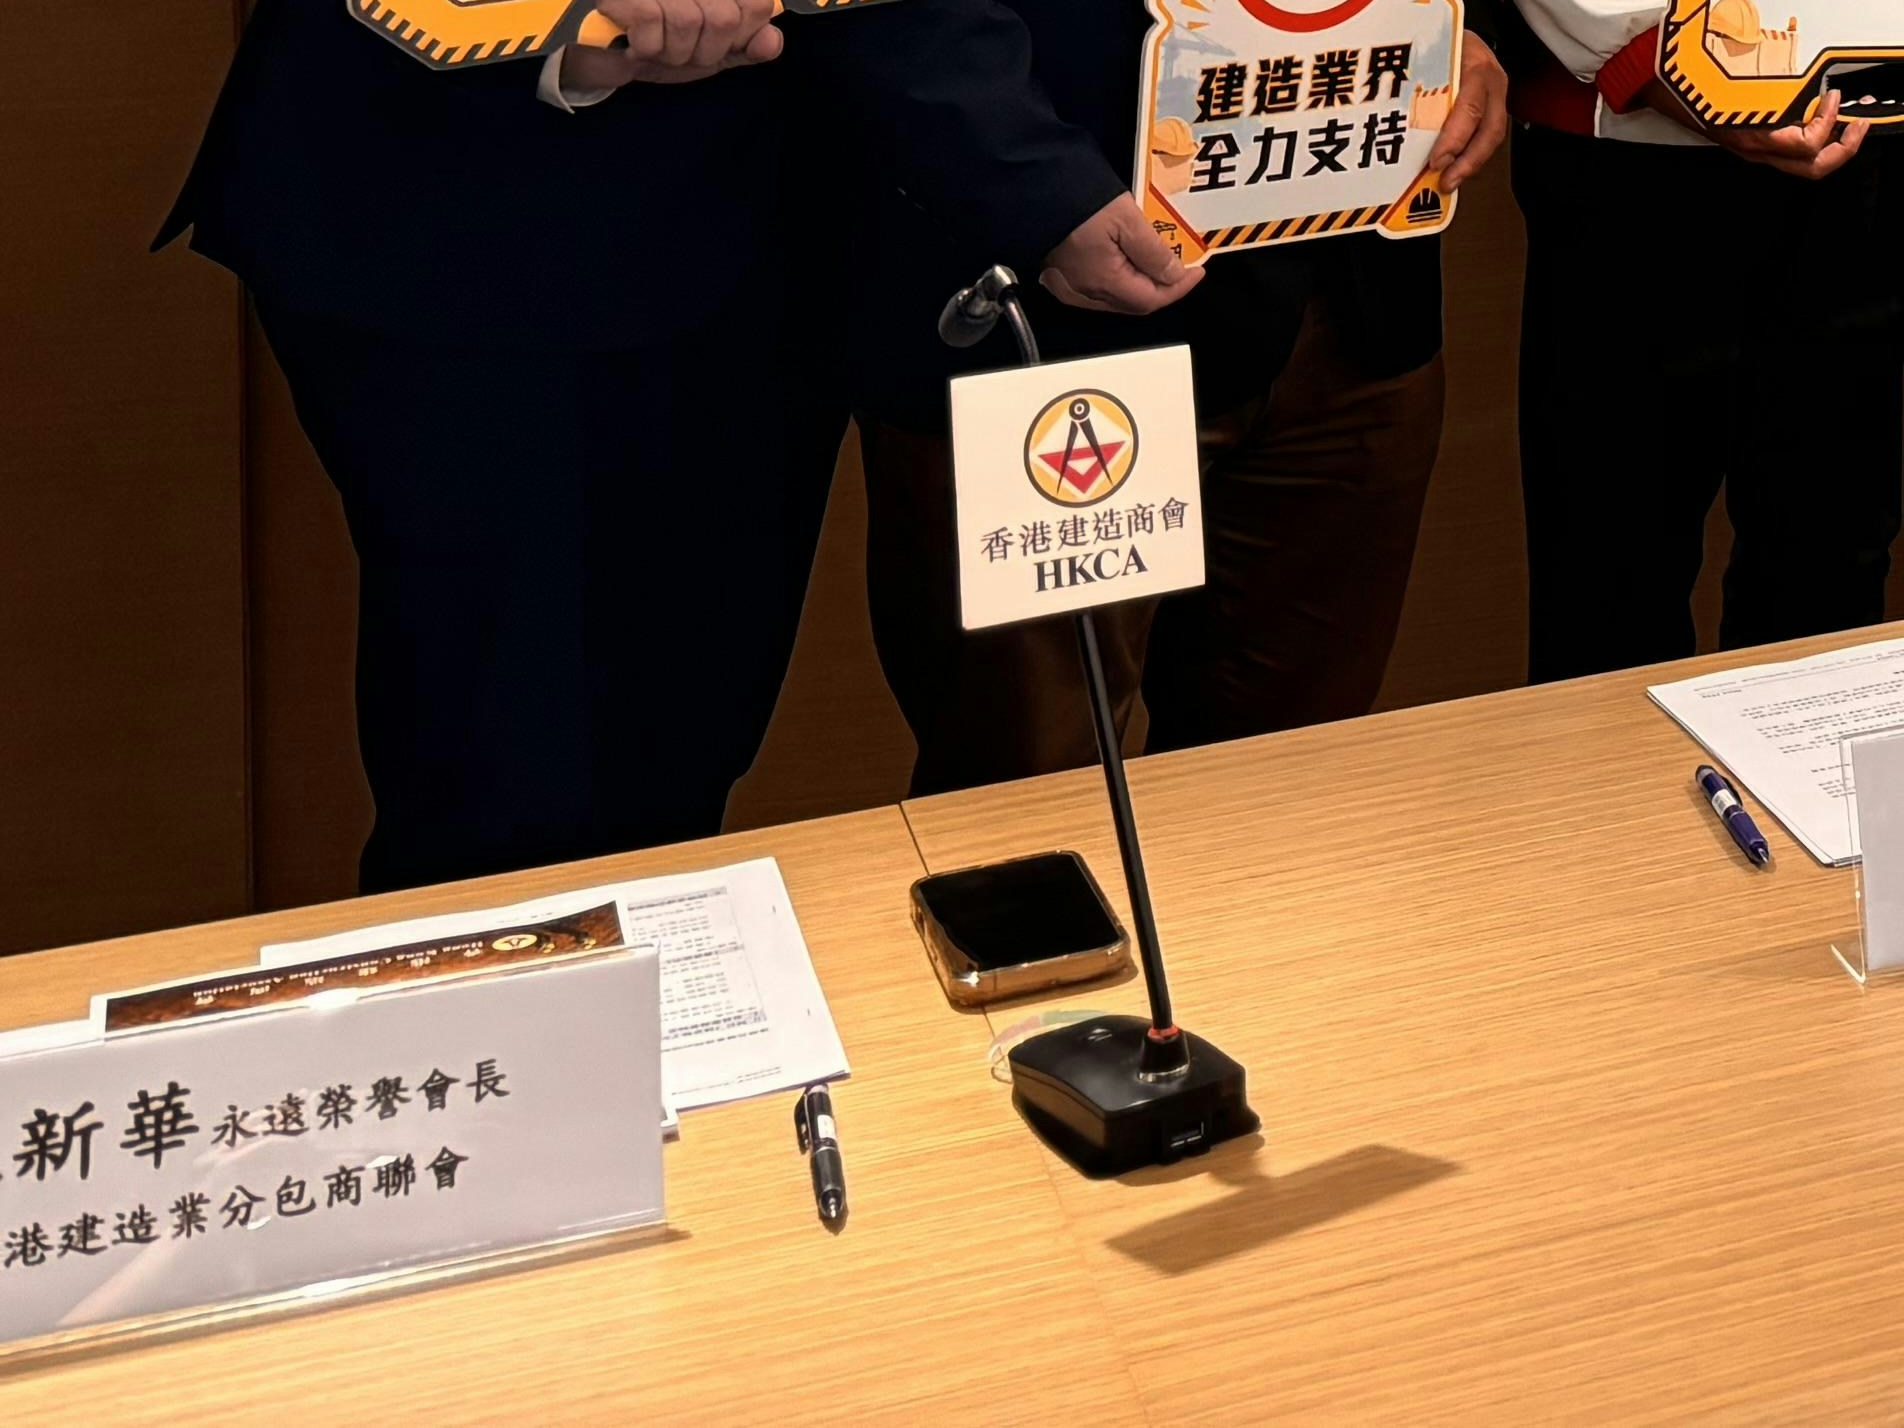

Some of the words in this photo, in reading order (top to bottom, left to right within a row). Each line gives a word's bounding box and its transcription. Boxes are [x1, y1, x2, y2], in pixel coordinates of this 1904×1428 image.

[1193, 43, 1414, 124] 建造業界
[1188, 110, 1406, 194] 全力支持
[980, 496, 1189, 564] 香港建造商會
[1033, 544, 1149, 593] HKCA
[0, 1081, 201, 1181] 新華
[210, 1058, 510, 1148] 永遠榮譽會長
[3, 1146, 470, 1269] 港建造業分包商聯會
